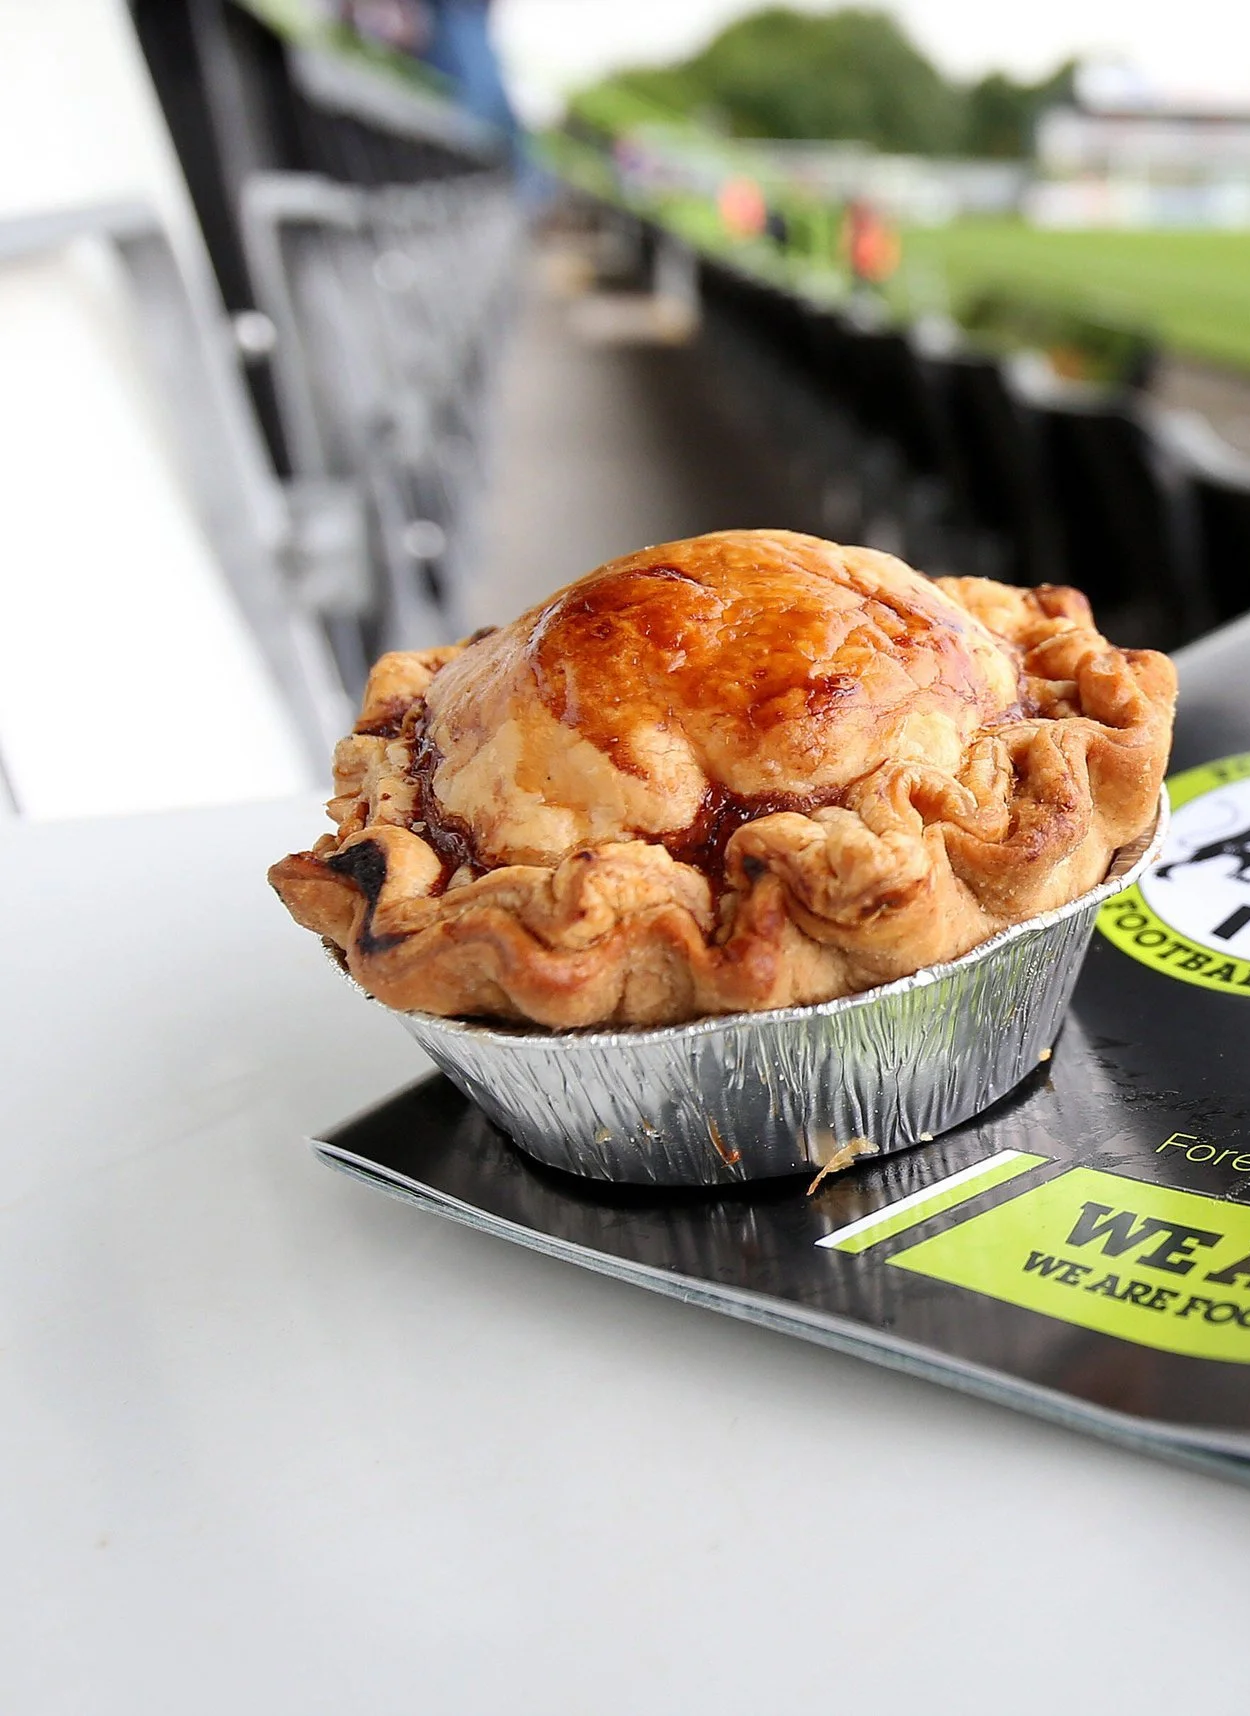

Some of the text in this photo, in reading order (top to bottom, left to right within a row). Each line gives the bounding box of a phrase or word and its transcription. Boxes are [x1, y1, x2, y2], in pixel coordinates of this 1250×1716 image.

[1065, 1201, 1224, 1276] WE
[1022, 1250, 1093, 1287] WE
[1085, 1273, 1180, 1313] ARE
